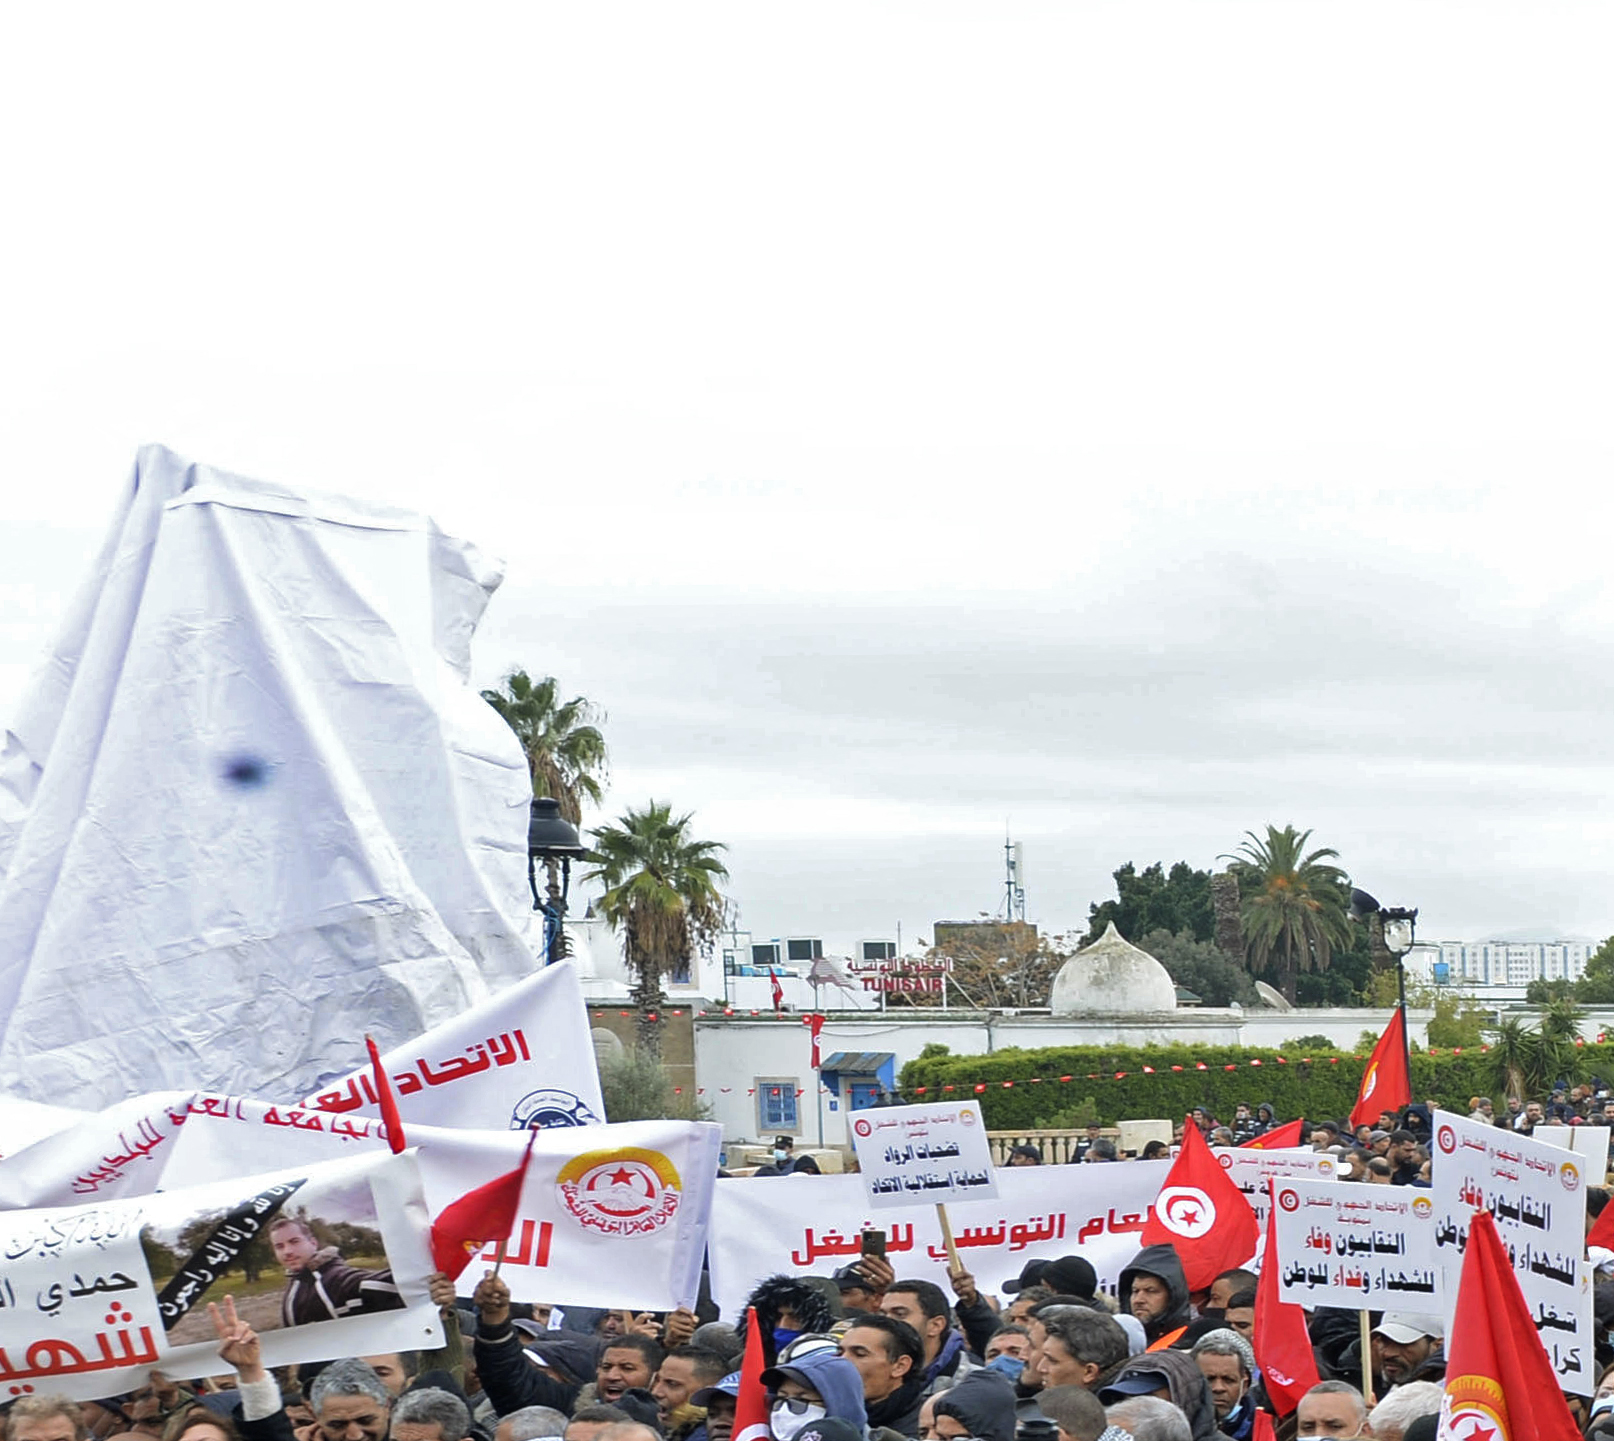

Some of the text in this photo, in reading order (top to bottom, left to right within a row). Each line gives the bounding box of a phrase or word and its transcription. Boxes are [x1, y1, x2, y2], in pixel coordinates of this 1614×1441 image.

[393, 1030, 531, 1095] الاتحاد
[1078, 1203, 1156, 1245] لعام
[1485, 1190, 1553, 1233] النقابيون
[1304, 1225, 1406, 1259] النقابيون وفاء
[1282, 1260, 1434, 1295] للشهداء وفداء للوطن
[1518, 1242, 1577, 1288] للشهداء
[37, 1270, 138, 1317] حمدي
